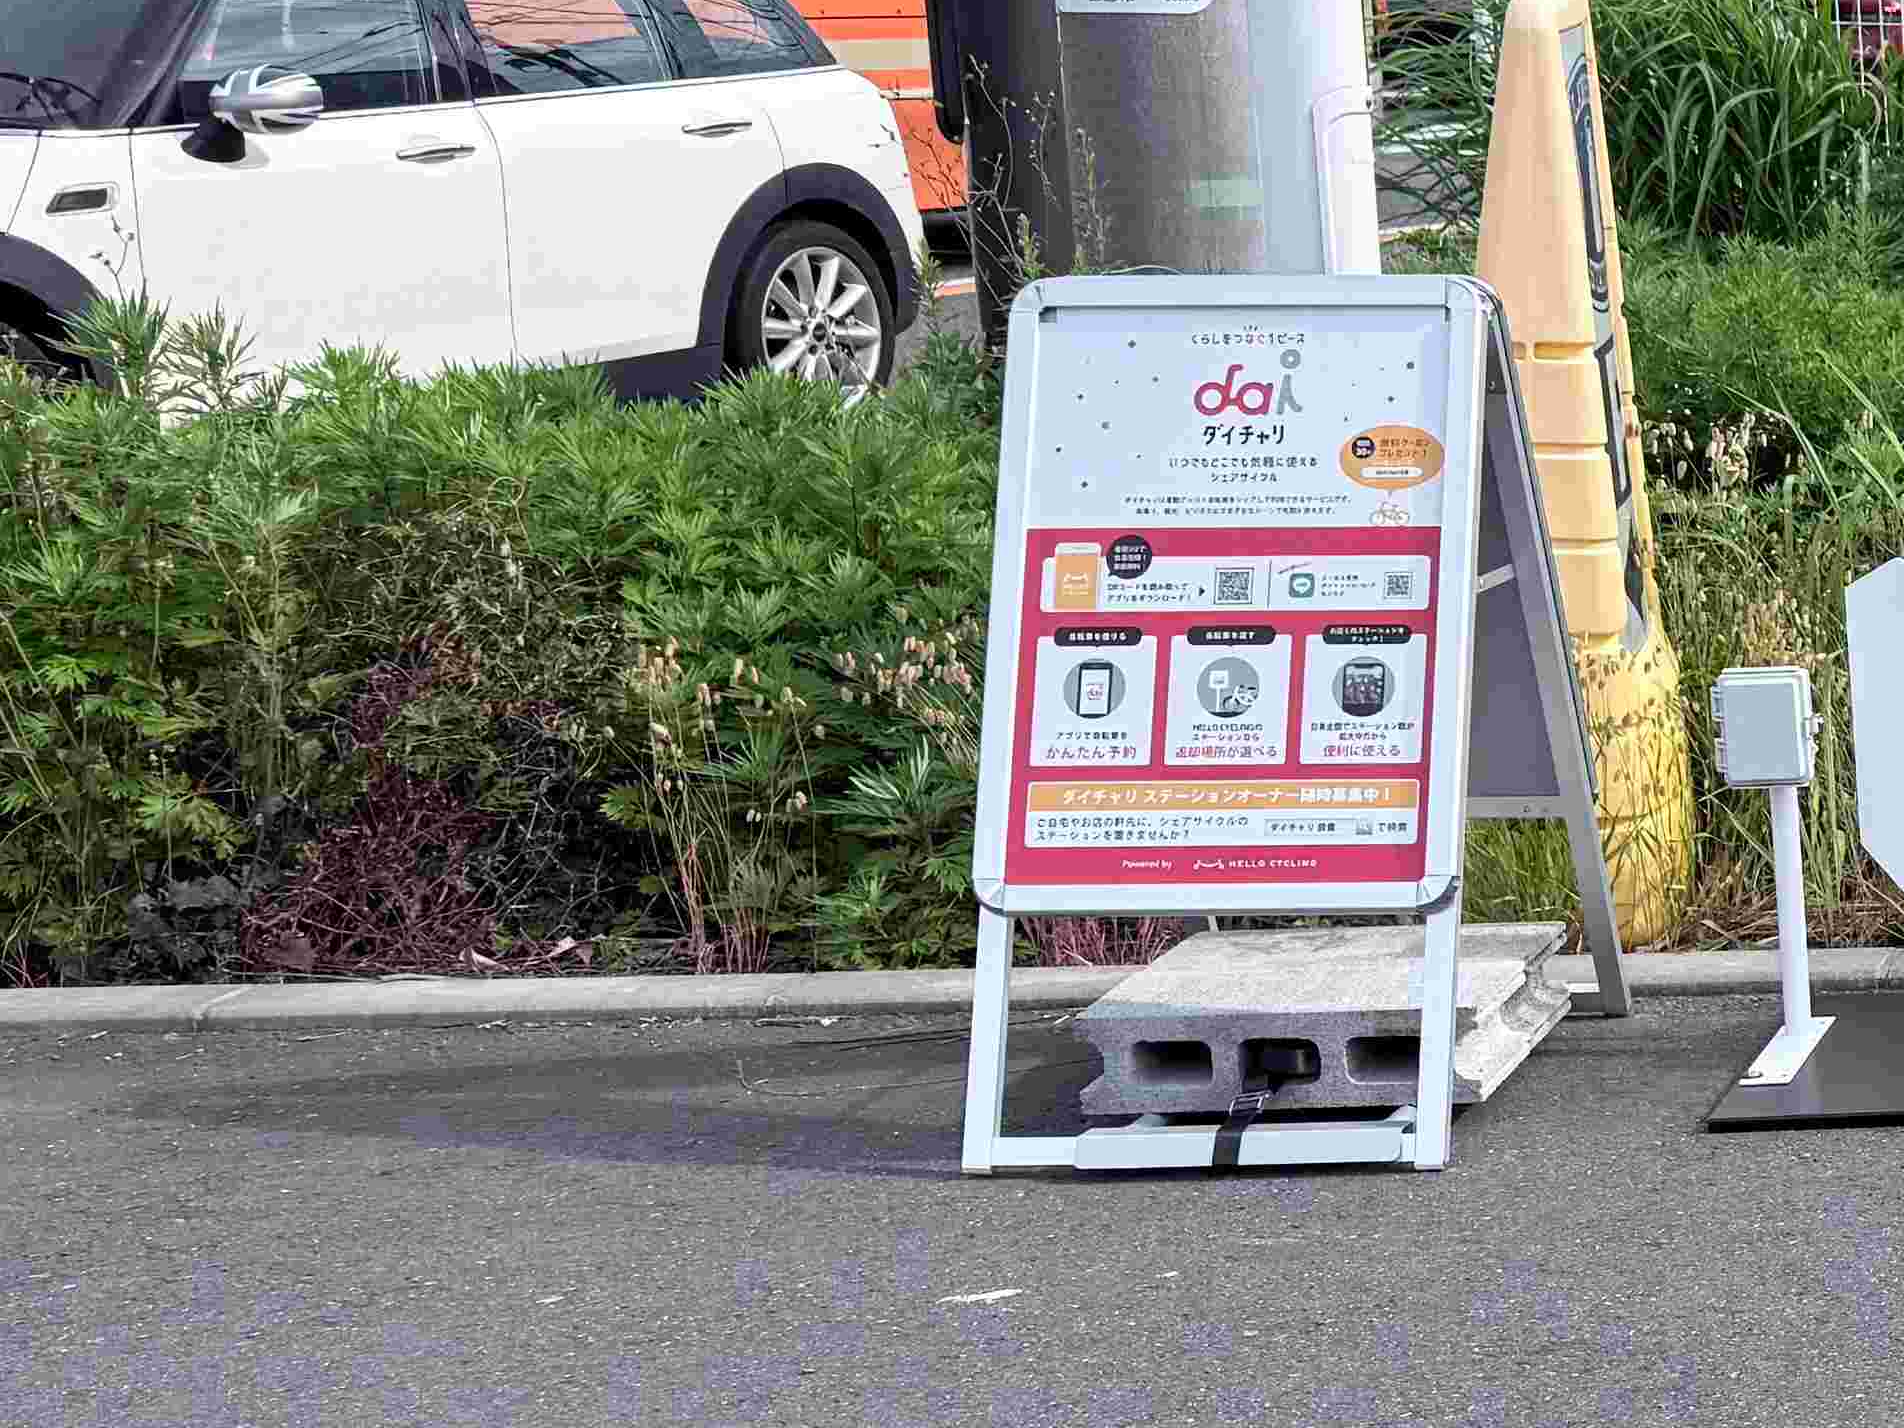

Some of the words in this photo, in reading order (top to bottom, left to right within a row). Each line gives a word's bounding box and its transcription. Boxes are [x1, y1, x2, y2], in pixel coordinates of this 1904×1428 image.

[1202, 423, 1286, 446] ダイチャリ
[1046, 745, 1137, 760] かんたん予約
[1063, 787, 1137, 805] ダイチャリ
